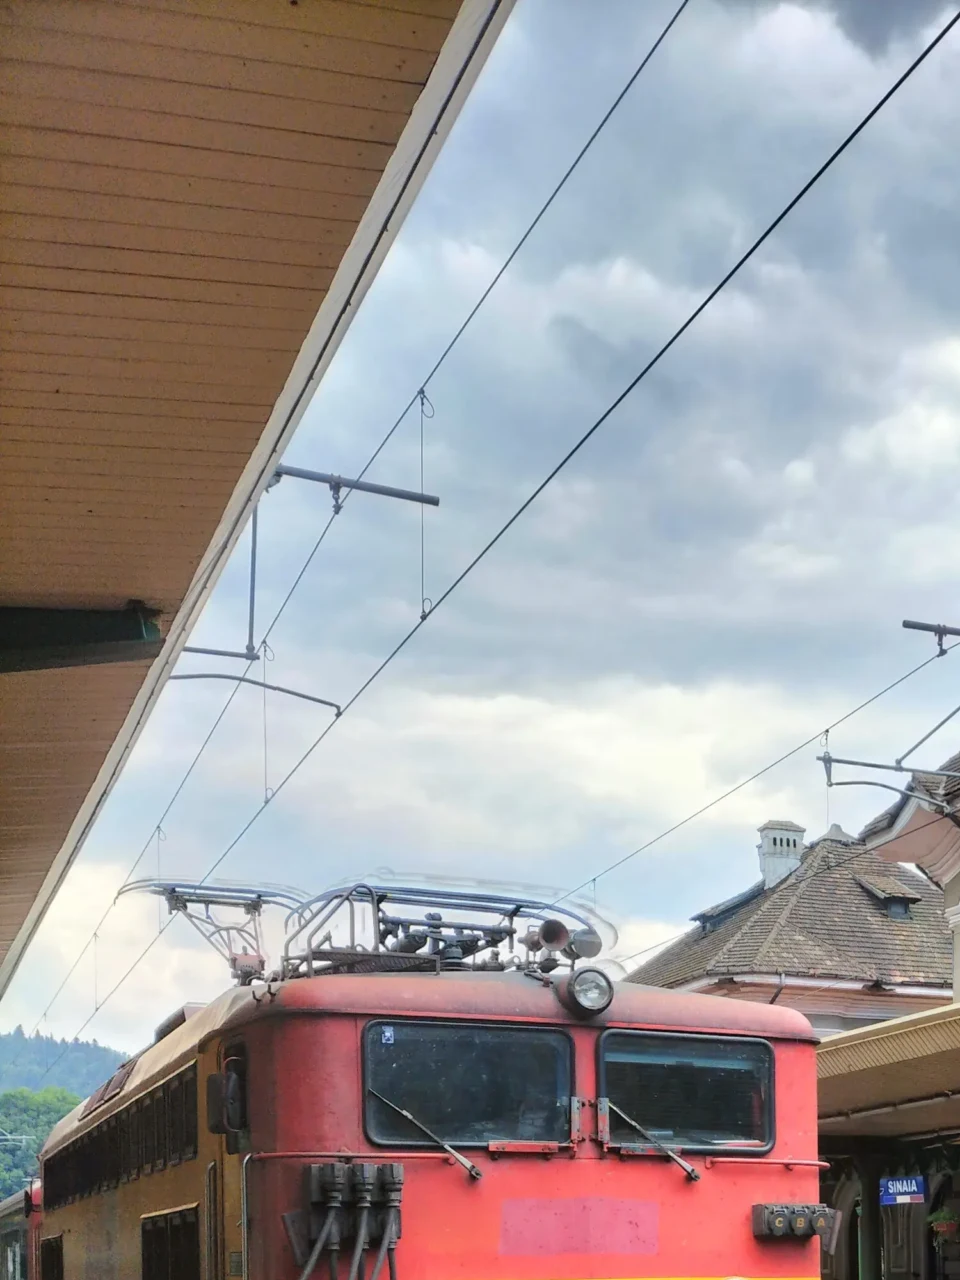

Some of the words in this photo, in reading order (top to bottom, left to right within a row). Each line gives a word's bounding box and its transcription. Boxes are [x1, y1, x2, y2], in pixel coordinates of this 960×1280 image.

[888, 1180, 917, 1193] SINAIA
[775, 1217, 783, 1227] C
[796, 1217, 805, 1228] B
[816, 1217, 825, 1227] A
